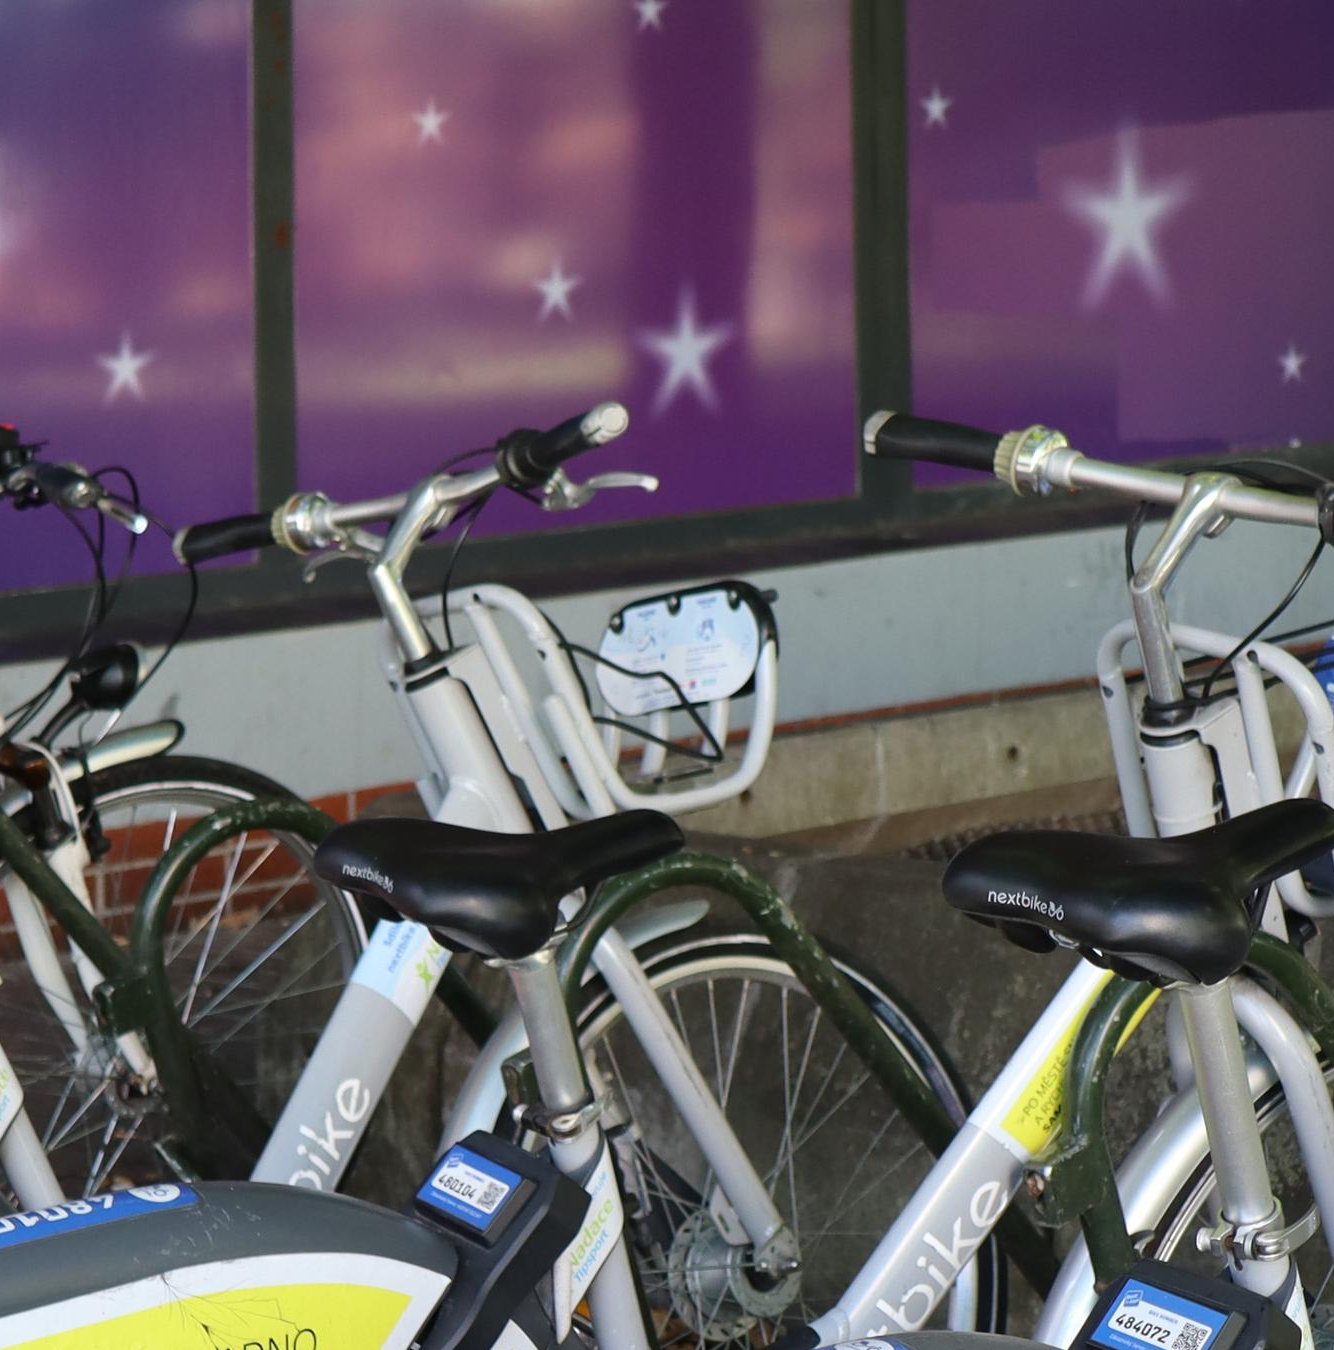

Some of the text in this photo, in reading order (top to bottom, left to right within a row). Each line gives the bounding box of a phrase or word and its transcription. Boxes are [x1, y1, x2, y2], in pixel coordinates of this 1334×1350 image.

[341, 863, 385, 887] nextbike
[987, 890, 1048, 914] nextbike
[438, 1173, 479, 1199] 480104
[1115, 1313, 1171, 1344] 484072
